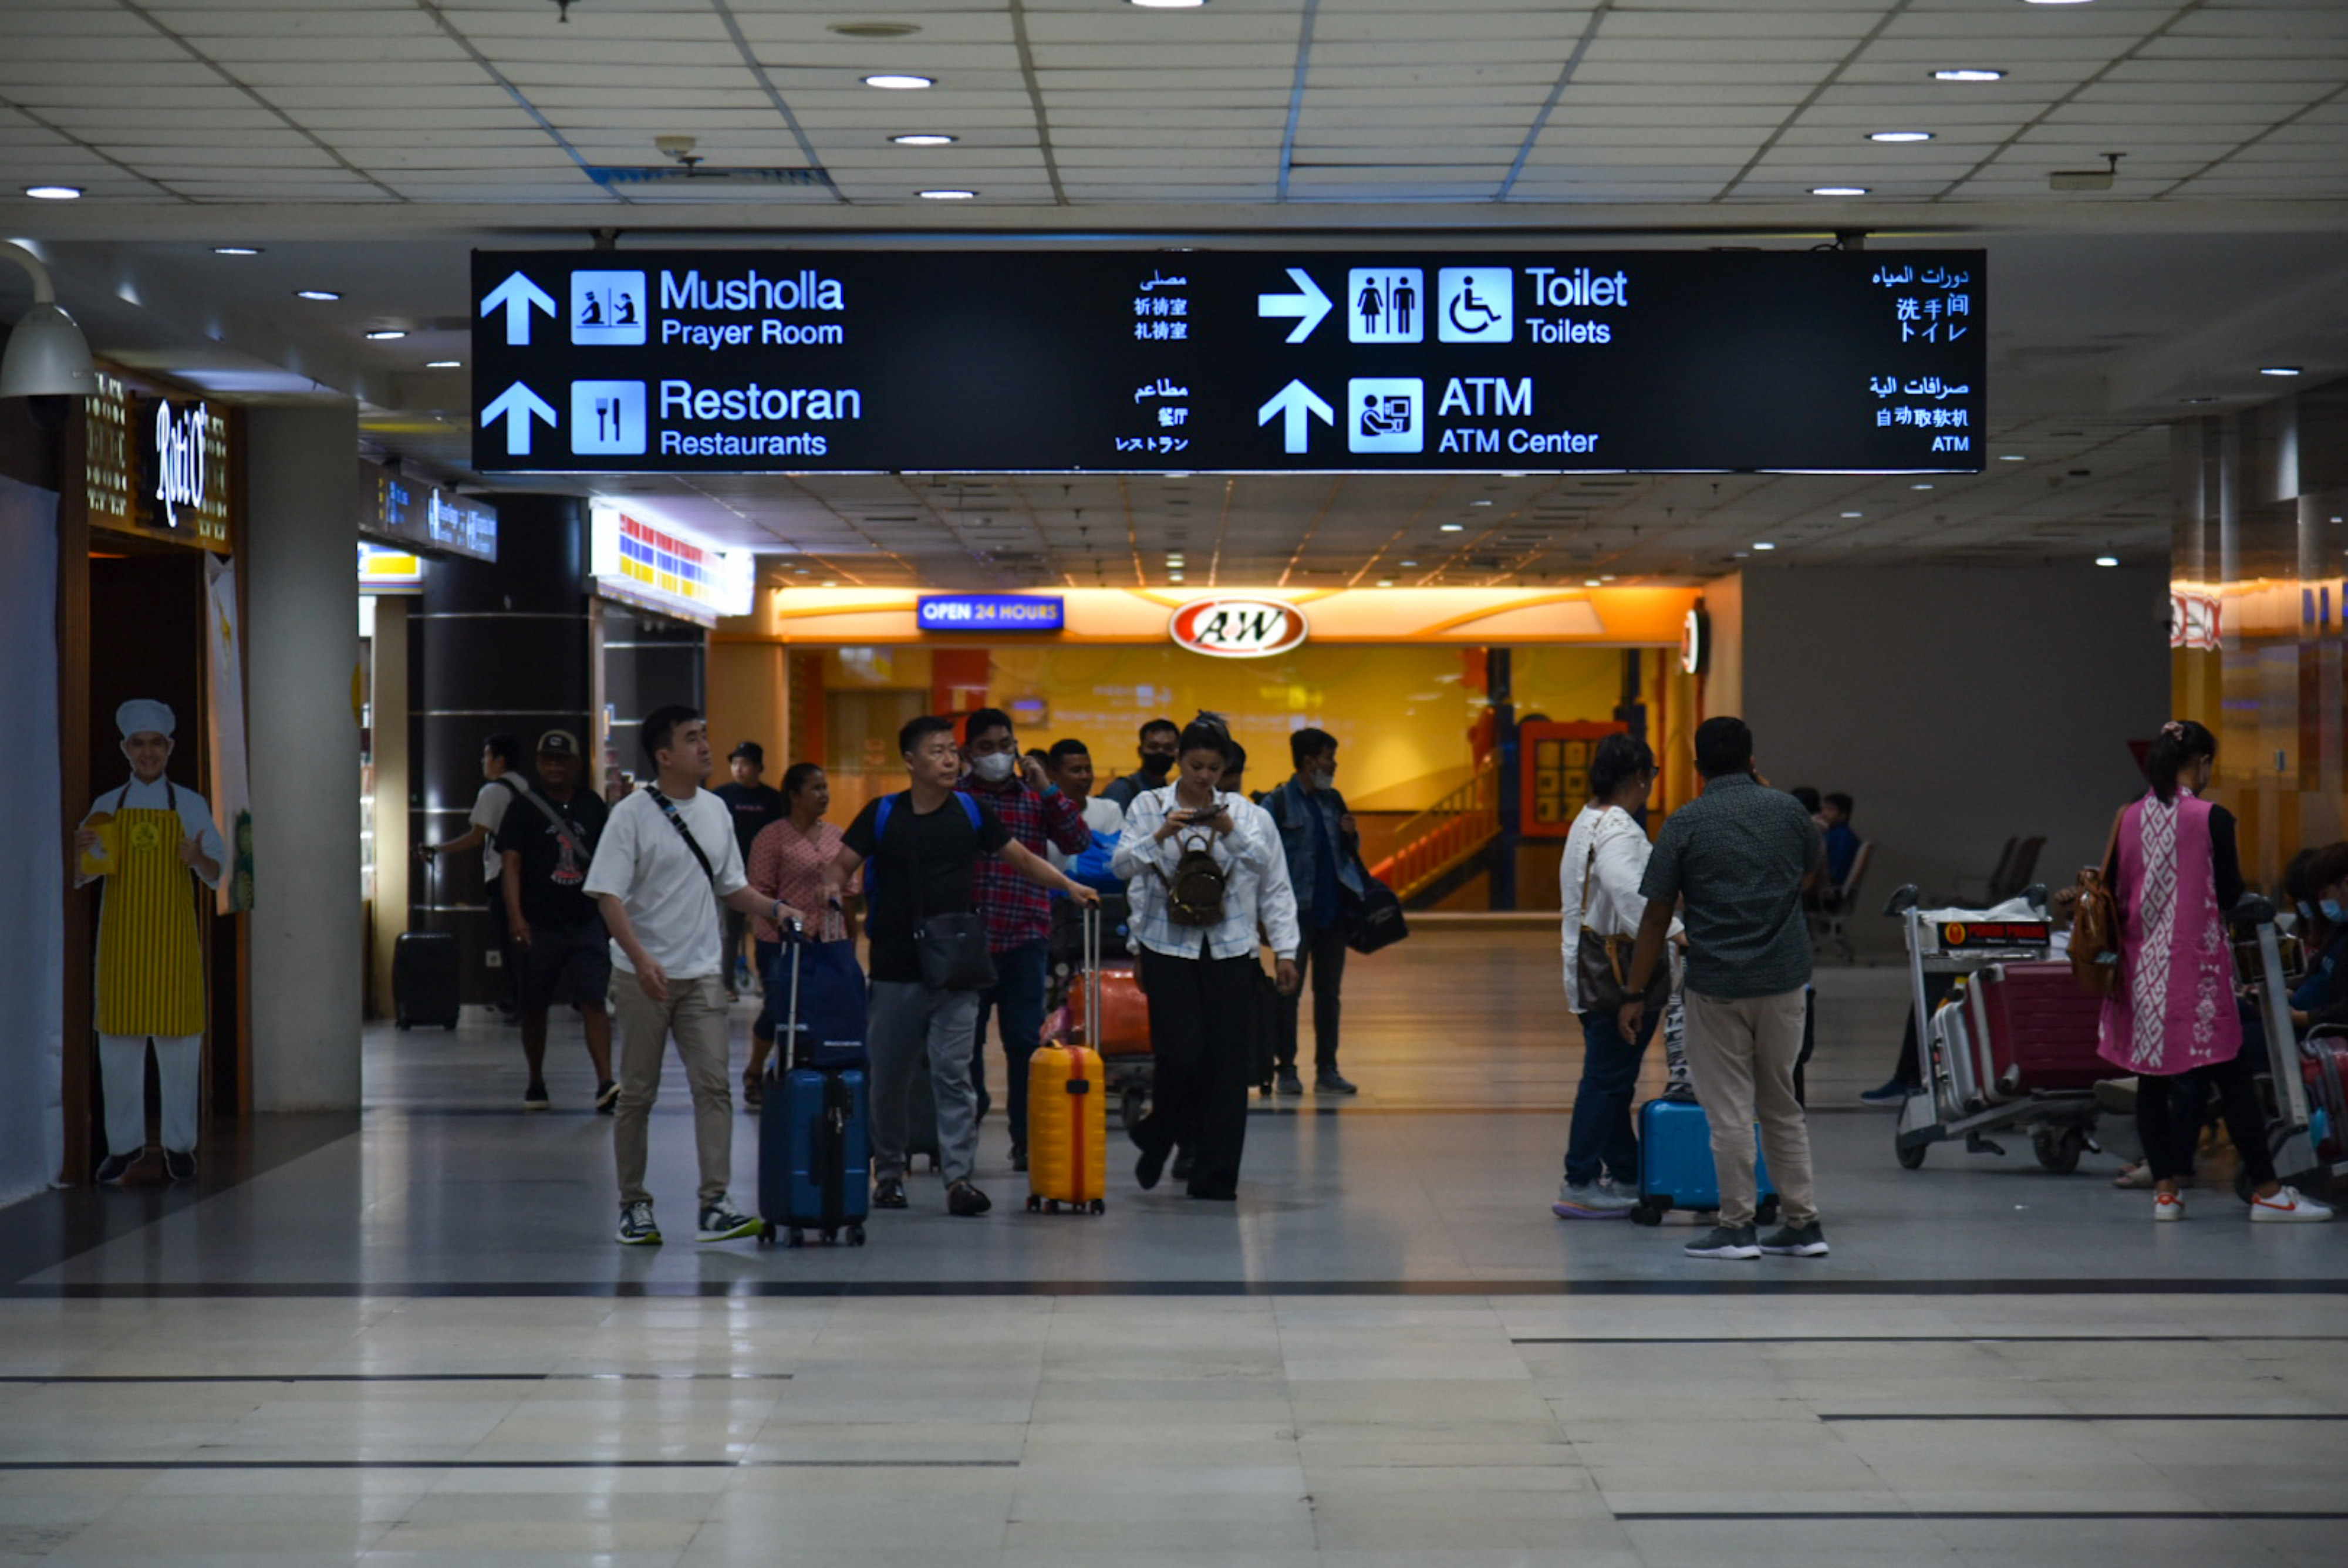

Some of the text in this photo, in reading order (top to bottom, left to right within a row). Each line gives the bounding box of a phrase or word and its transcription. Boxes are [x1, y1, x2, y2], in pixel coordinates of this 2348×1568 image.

[660, 270, 844, 311] Musholla
[1526, 268, 1628, 307] Toilet
[1896, 293, 1969, 322] 洗手间
[662, 319, 844, 350] Prayer Room
[1526, 318, 1611, 343] Toilets
[1902, 322, 1967, 343] トイレ
[660, 380, 861, 420] Restoran
[1134, 377, 1188, 404] مطاعم
[1439, 377, 1532, 416] ATM
[660, 430, 827, 456] Restaurants
[1115, 436, 1189, 454] レストラン
[1439, 429, 1598, 454] ATM Center
[1931, 436, 1969, 451] ATM
[923, 602, 1058, 620] OPEN 24 HOURS
